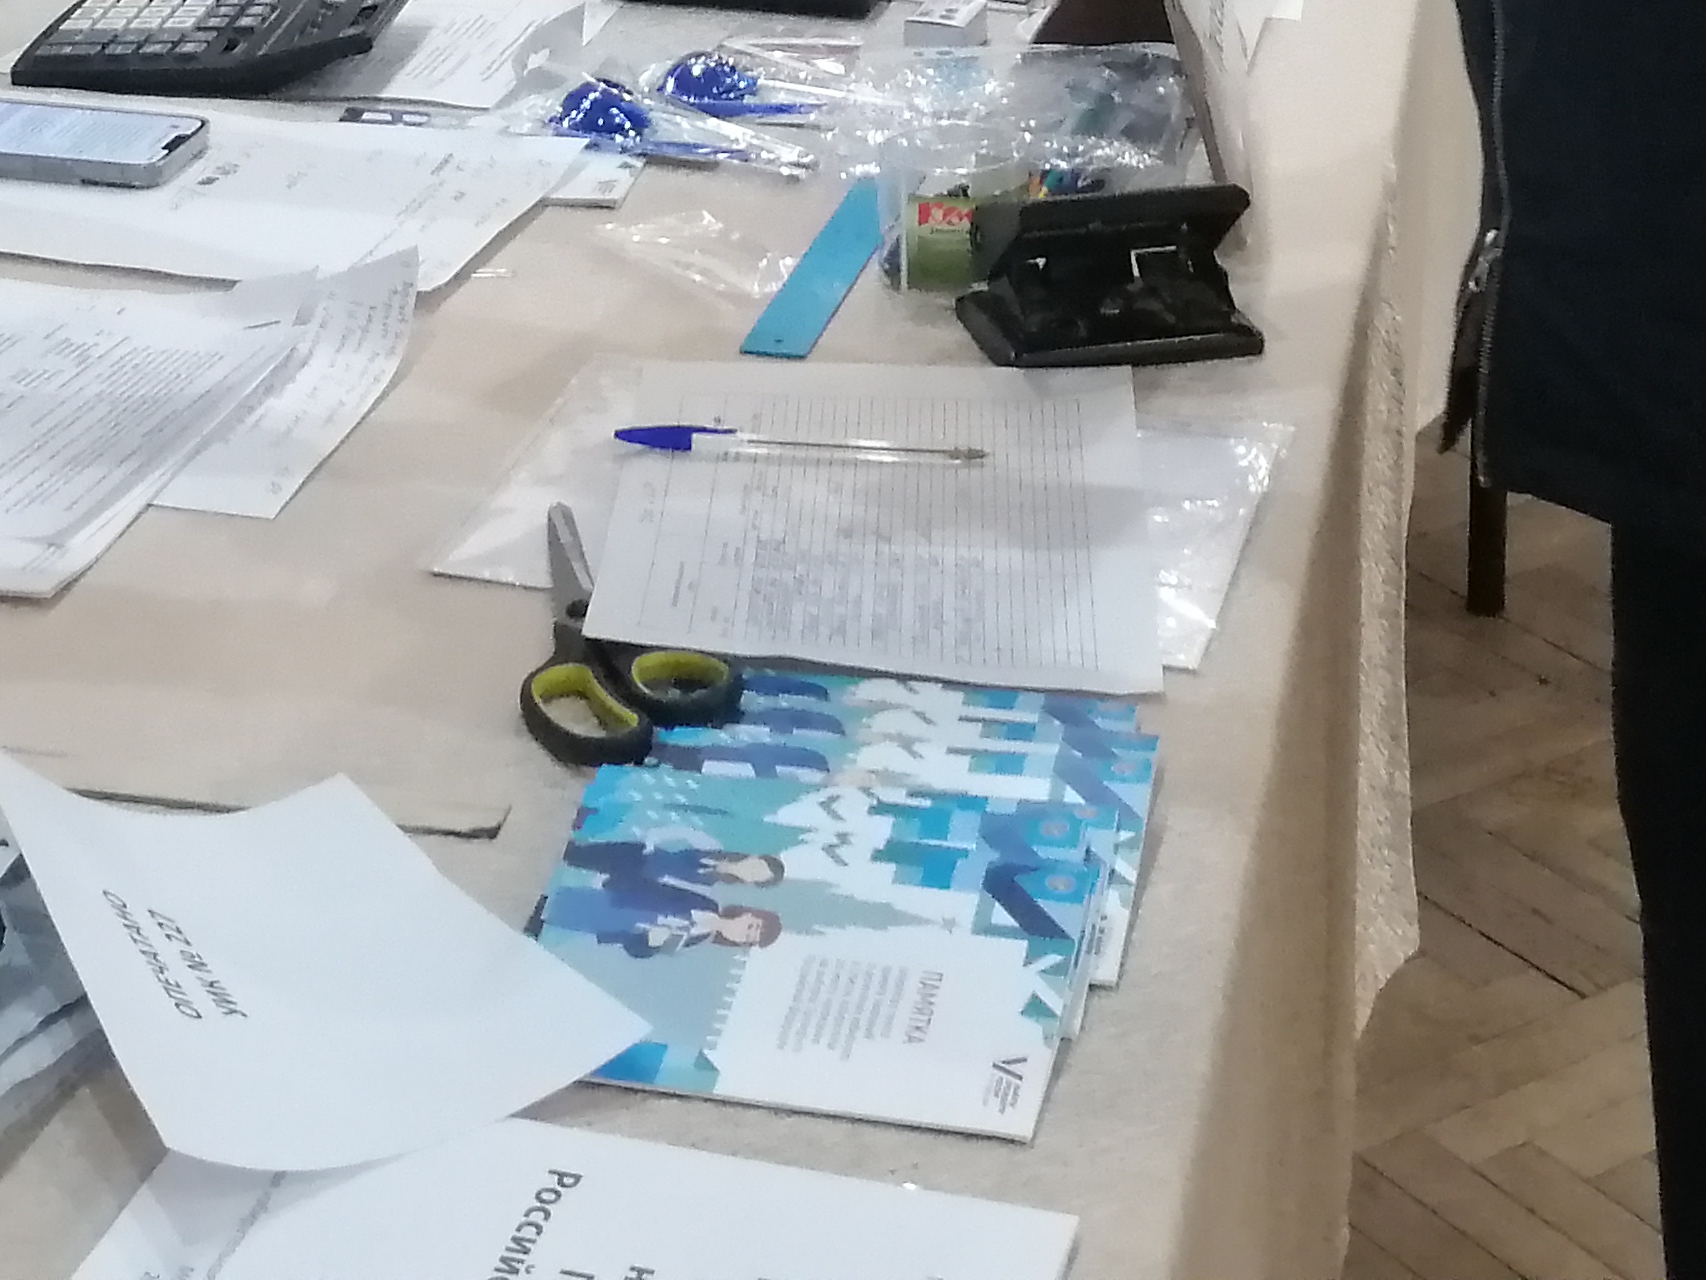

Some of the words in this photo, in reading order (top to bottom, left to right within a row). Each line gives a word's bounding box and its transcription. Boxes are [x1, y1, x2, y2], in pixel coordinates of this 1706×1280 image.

[102, 890, 203, 1019] ОПЕЧАТАНО
[902, 970, 945, 1045] ПАМЯТКА
[486, 1168, 584, 1280] Россий
